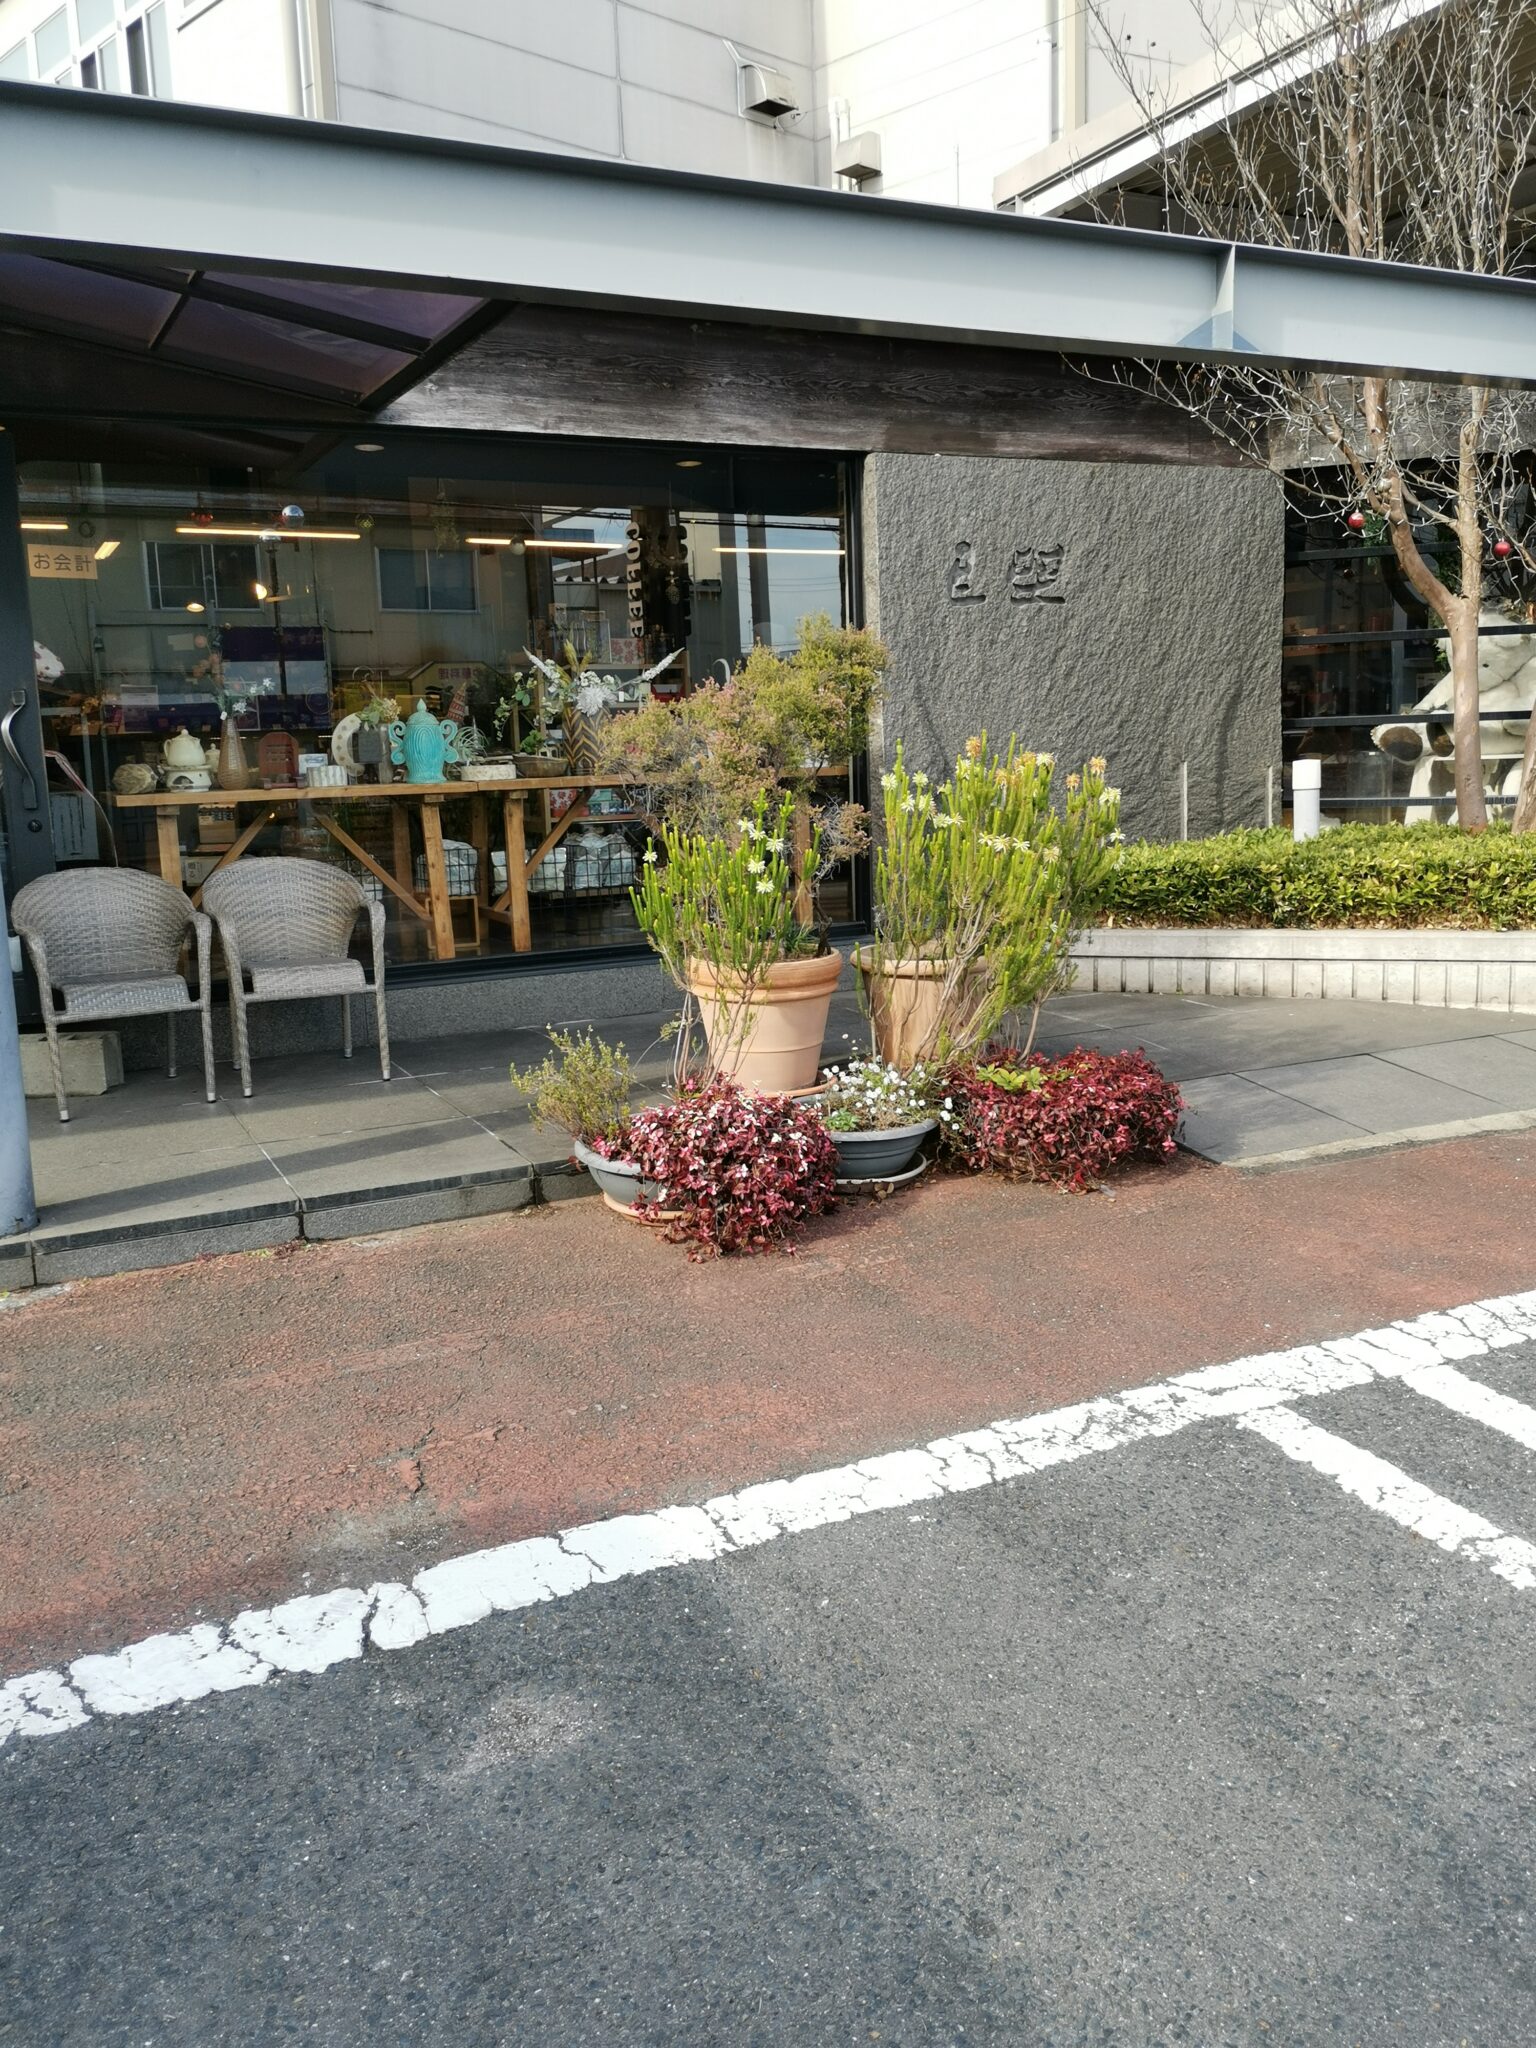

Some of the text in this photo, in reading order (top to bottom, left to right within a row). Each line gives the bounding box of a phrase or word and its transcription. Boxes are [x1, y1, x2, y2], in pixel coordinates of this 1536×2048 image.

[33, 553, 92, 572] お会計
[624, 521, 644, 638] COFFEE
